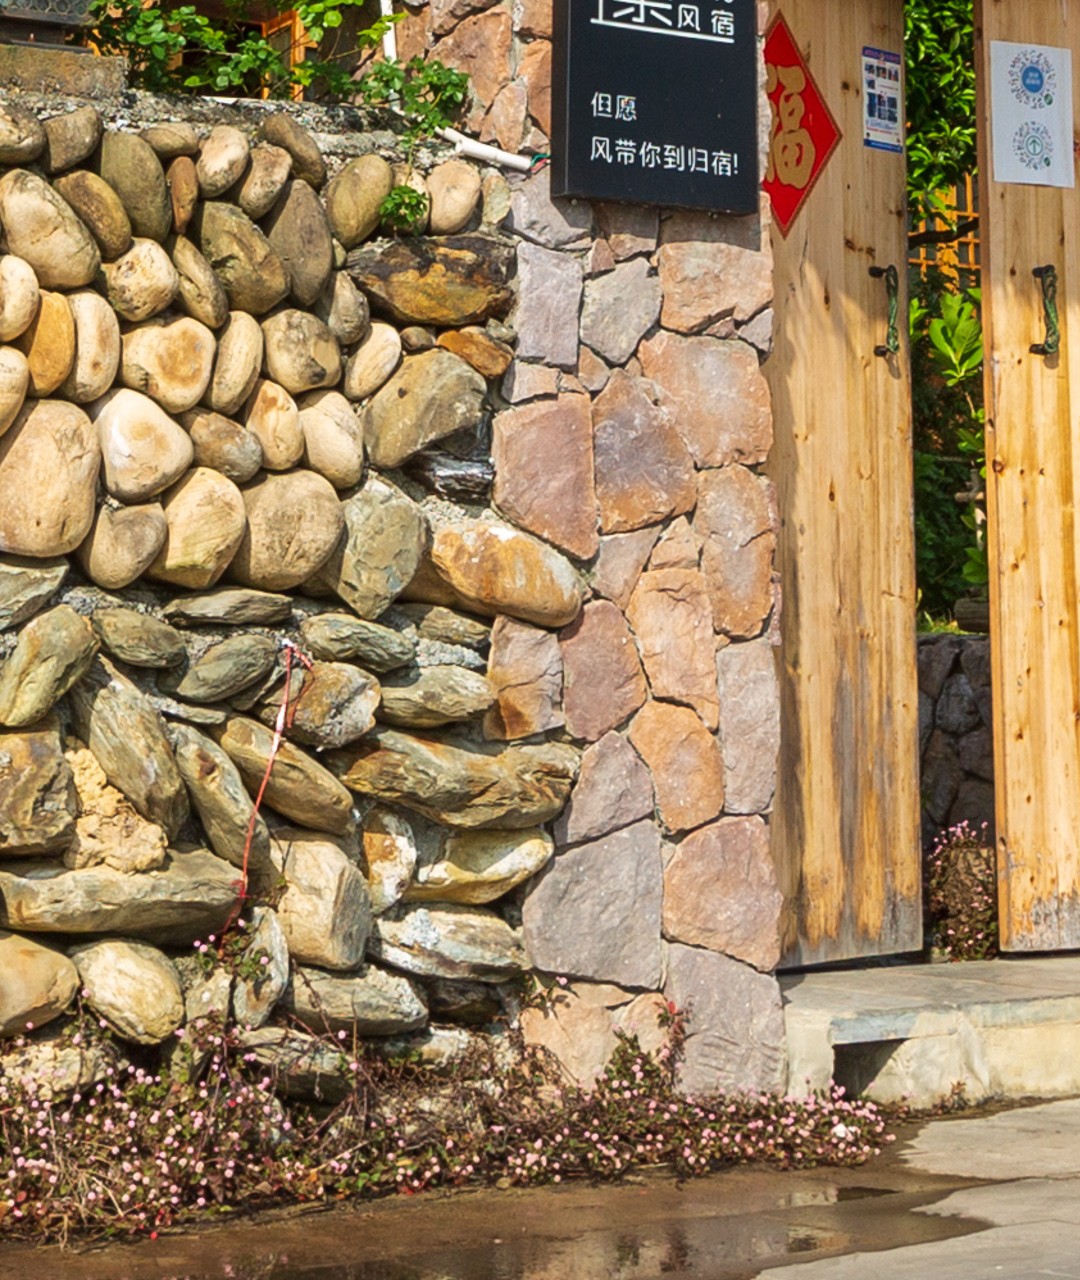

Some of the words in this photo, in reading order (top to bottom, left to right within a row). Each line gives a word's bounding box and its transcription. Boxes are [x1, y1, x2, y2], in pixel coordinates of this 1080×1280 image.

[677, 3, 734, 36] 风宿
[590, 91, 637, 122] 但愿
[590, 136, 738, 177] 风带你到归宿!
